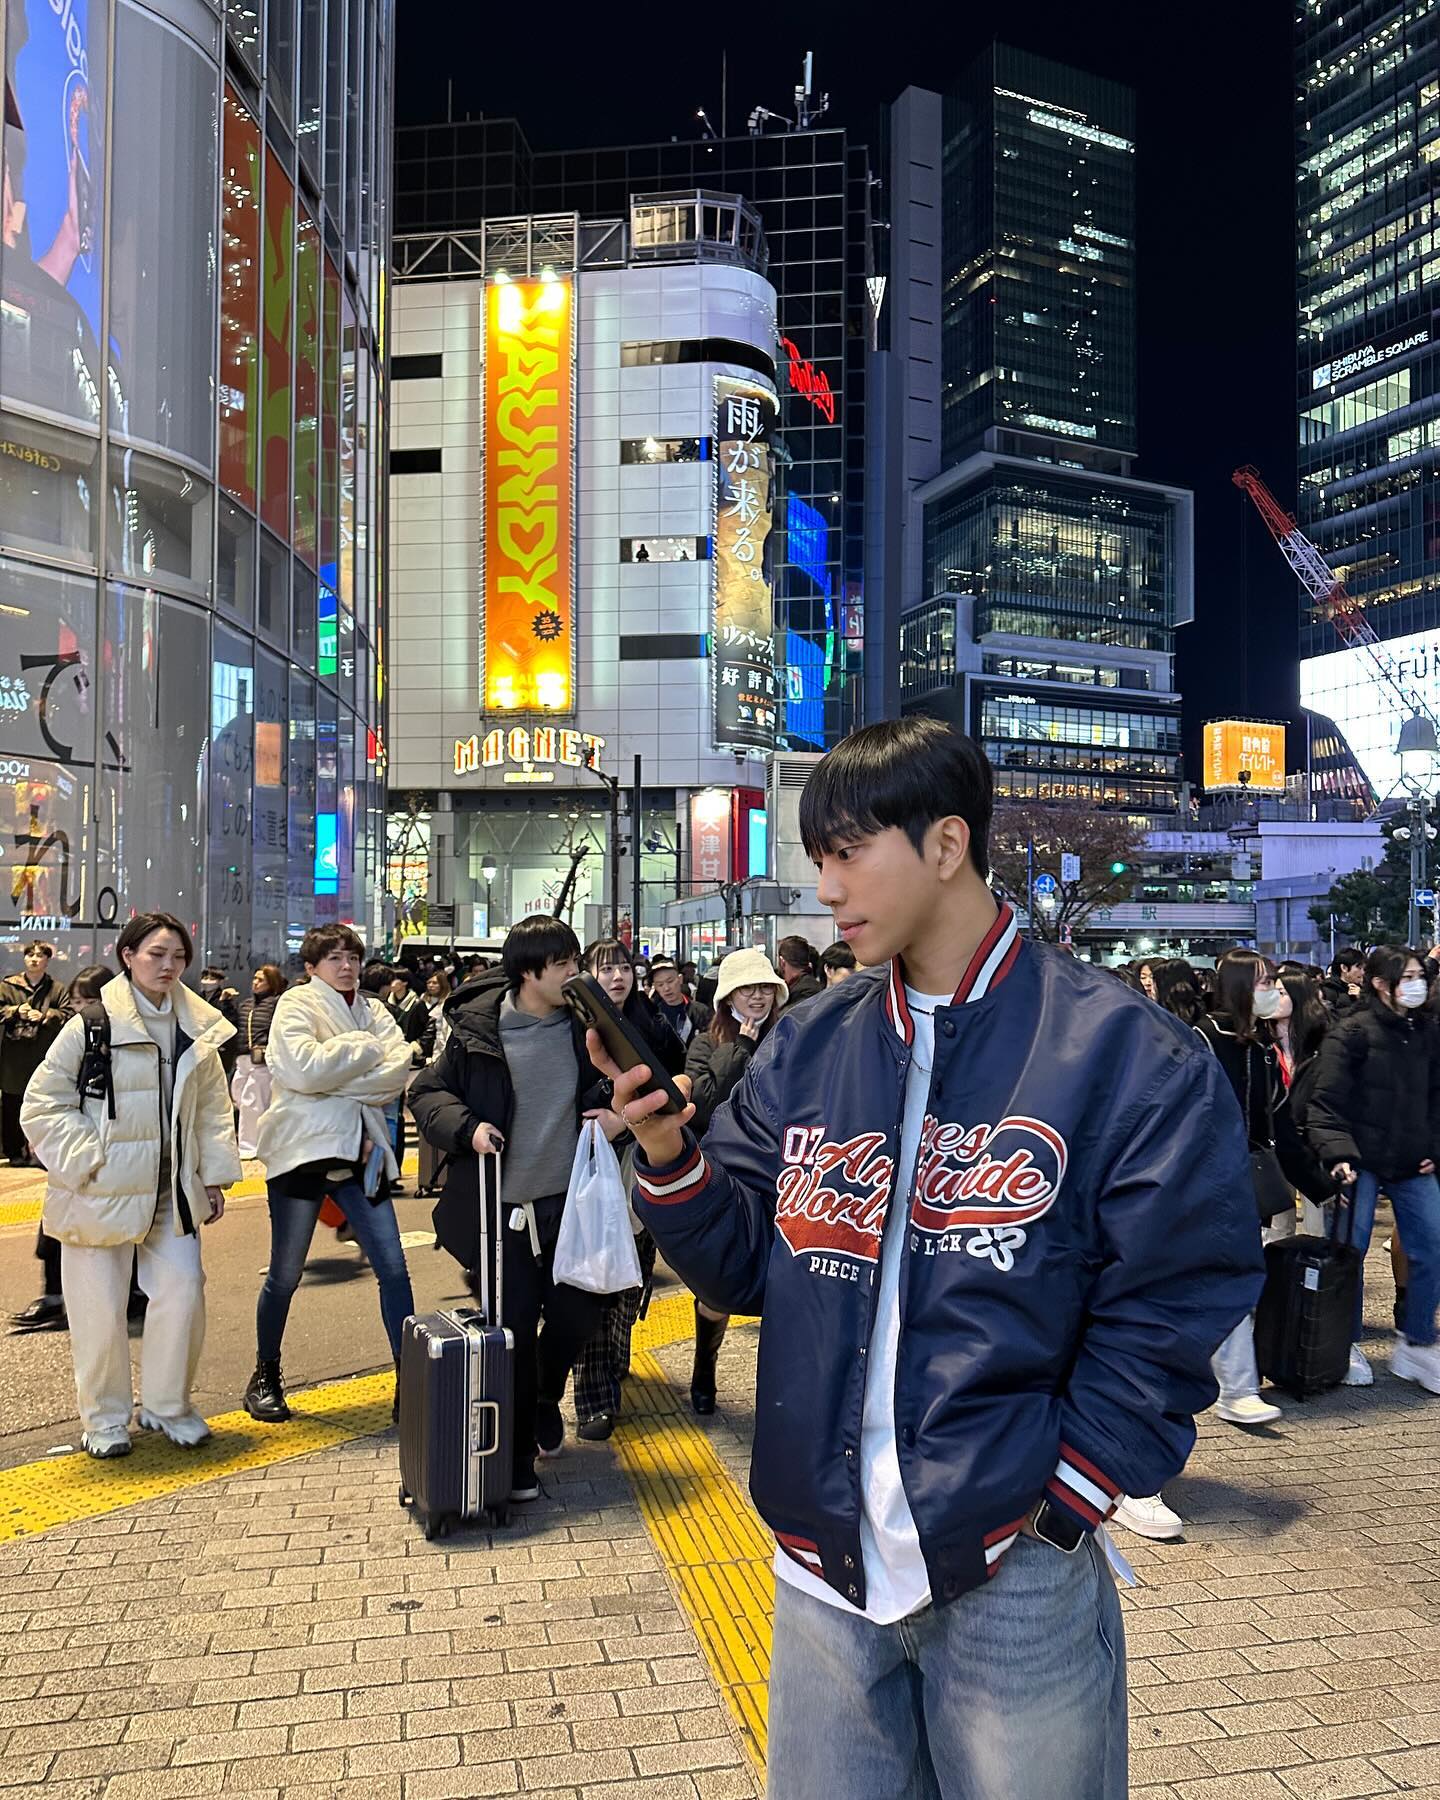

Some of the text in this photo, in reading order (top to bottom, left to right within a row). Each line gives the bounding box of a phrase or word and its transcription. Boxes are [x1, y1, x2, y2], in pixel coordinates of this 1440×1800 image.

[1332, 331, 1429, 381] SCRAMBLE SQUARE
[1332, 345, 1375, 371] SHIBUYA
[453, 726, 606, 775] MAGNET
[809, 1256, 861, 1283] PIECE
